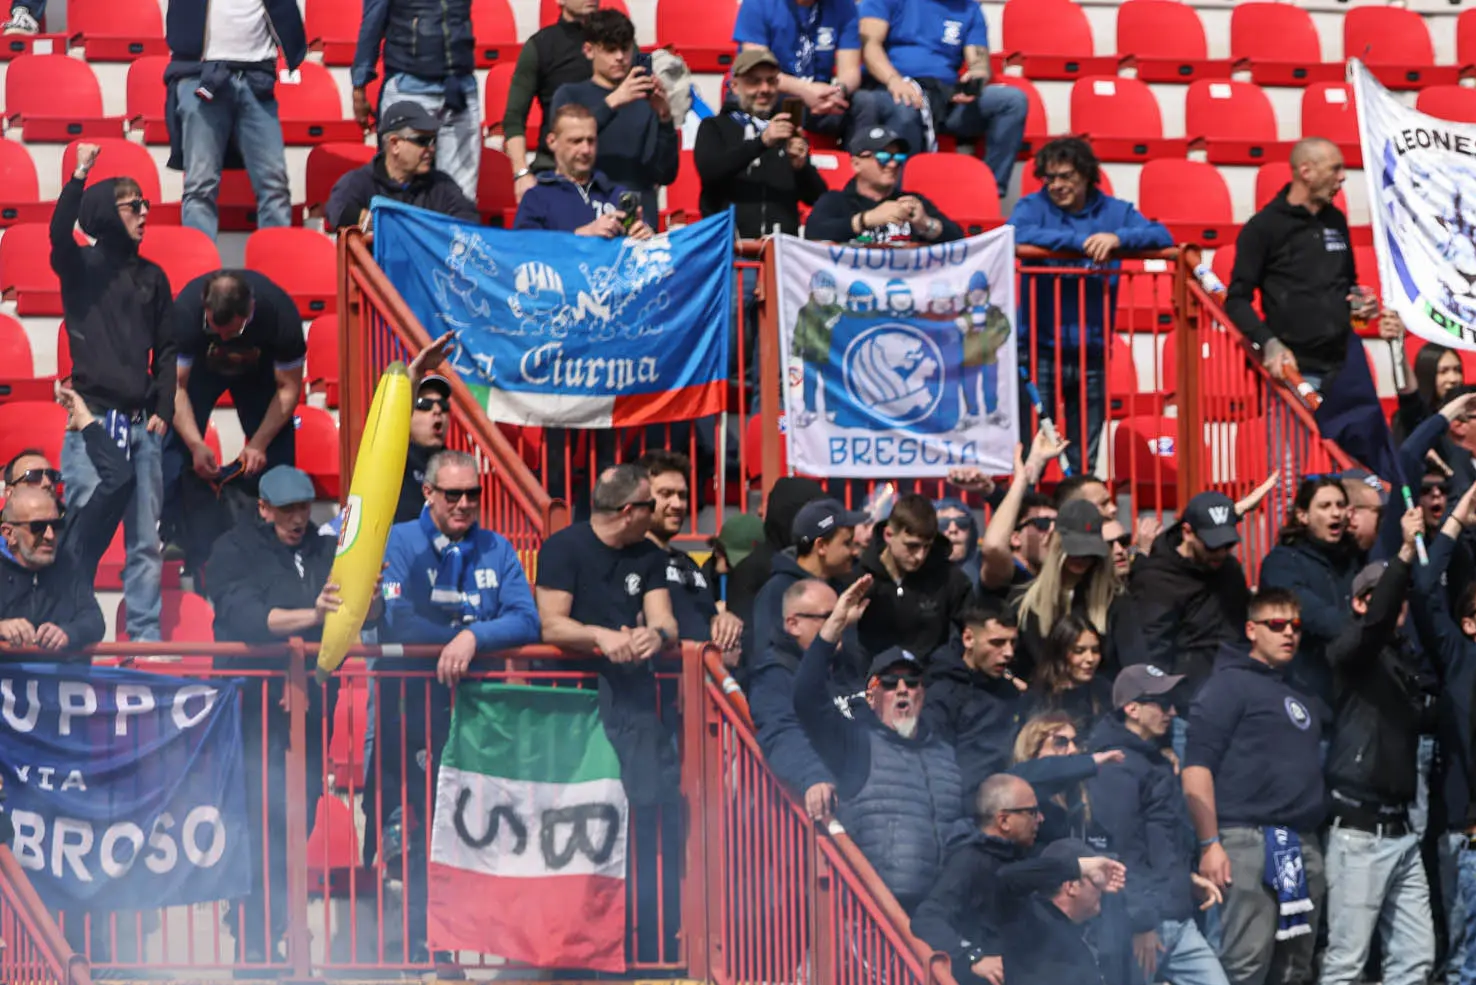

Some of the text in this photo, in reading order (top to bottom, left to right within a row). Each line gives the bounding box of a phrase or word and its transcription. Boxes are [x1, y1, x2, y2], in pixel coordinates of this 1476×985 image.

[451, 330, 660, 391] La Ciurma
[828, 436, 980, 467] BRESCIA
[15, 765, 87, 791] VIA
